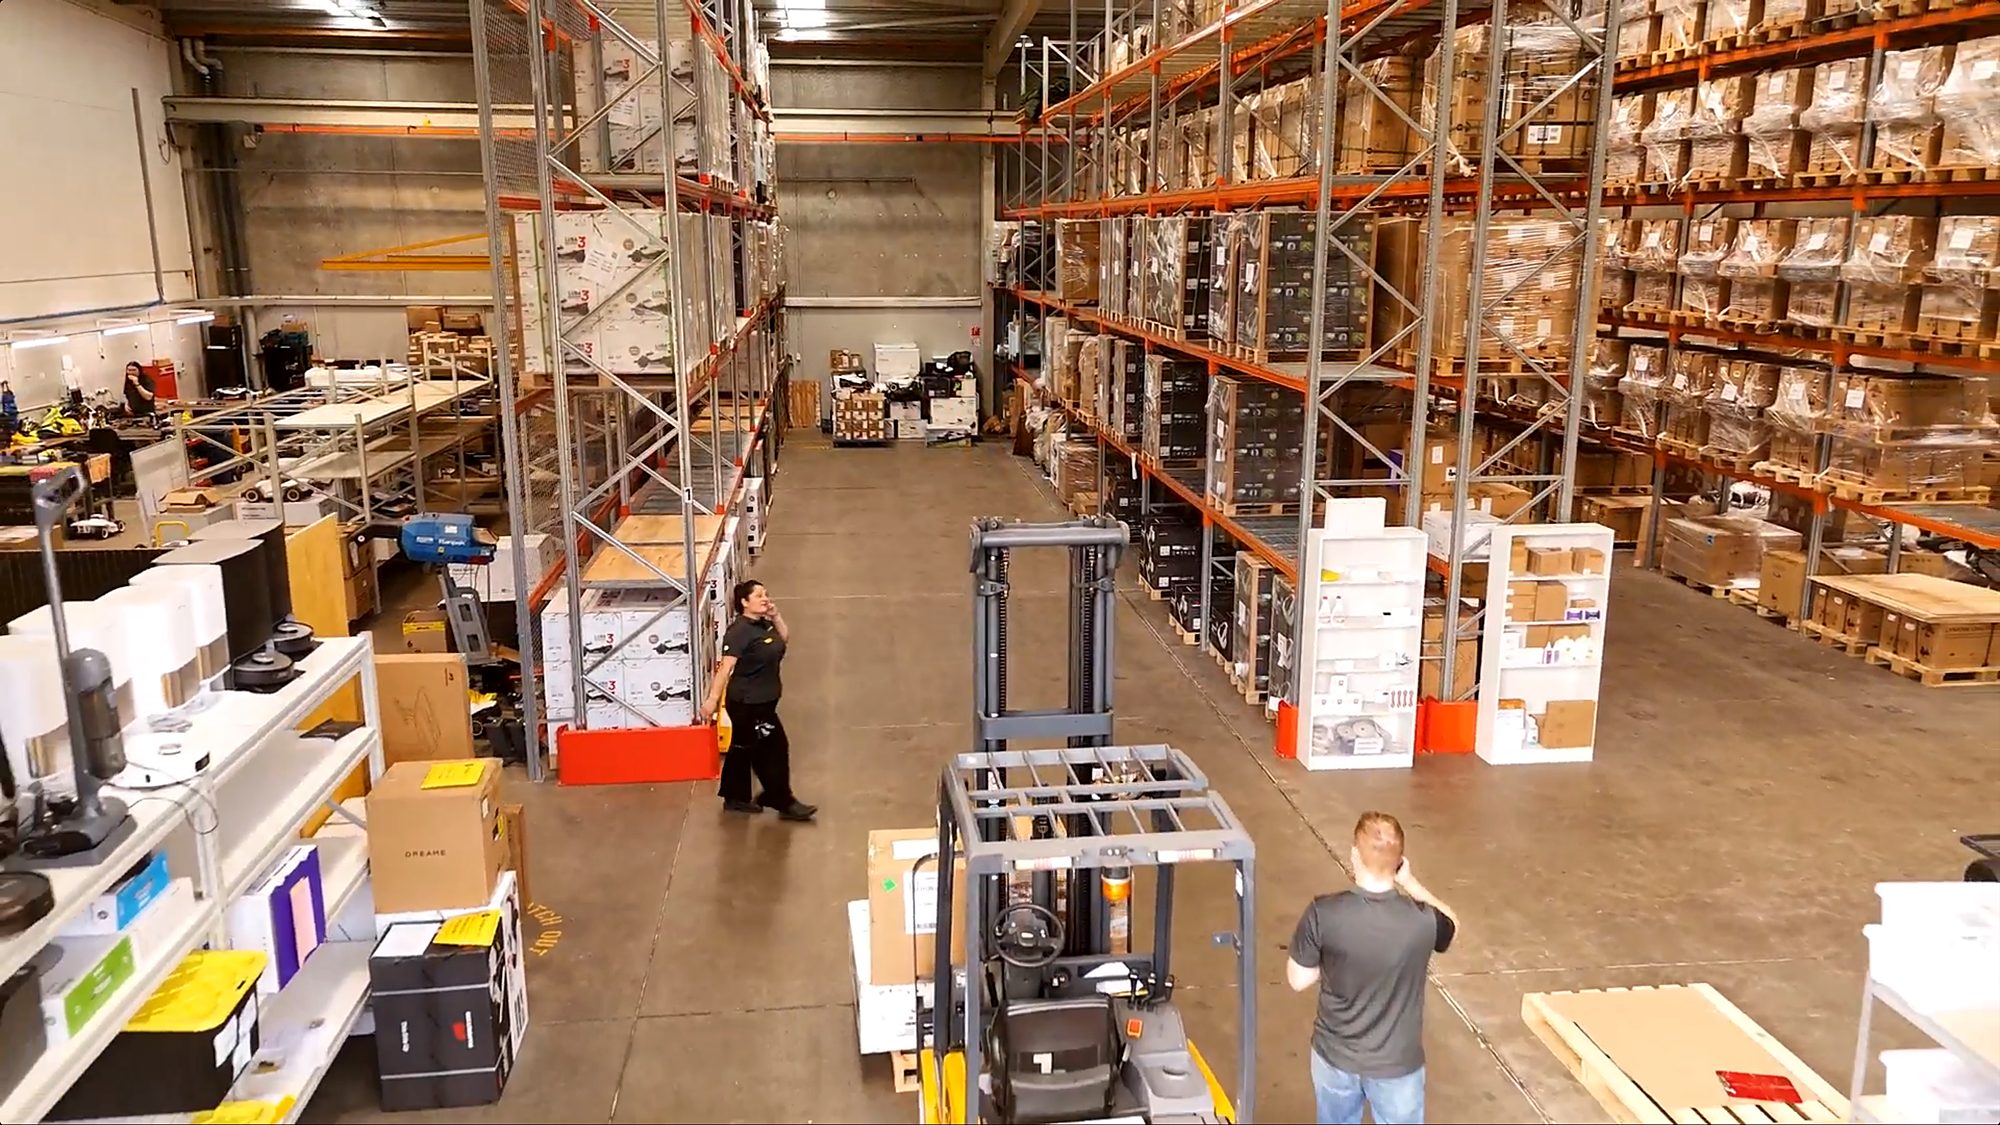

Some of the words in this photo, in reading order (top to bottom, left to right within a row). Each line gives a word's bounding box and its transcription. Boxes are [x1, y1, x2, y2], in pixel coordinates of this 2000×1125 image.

[622, 59, 630, 69] 3
[577, 236, 587, 248] 3
[580, 289, 590, 301] 3
[584, 342, 593, 354] 3
[684, 489, 691, 500] 1
[606, 633, 614, 643] 3
[608, 680, 617, 691] 3
[528, 930, 562, 956] OUT
